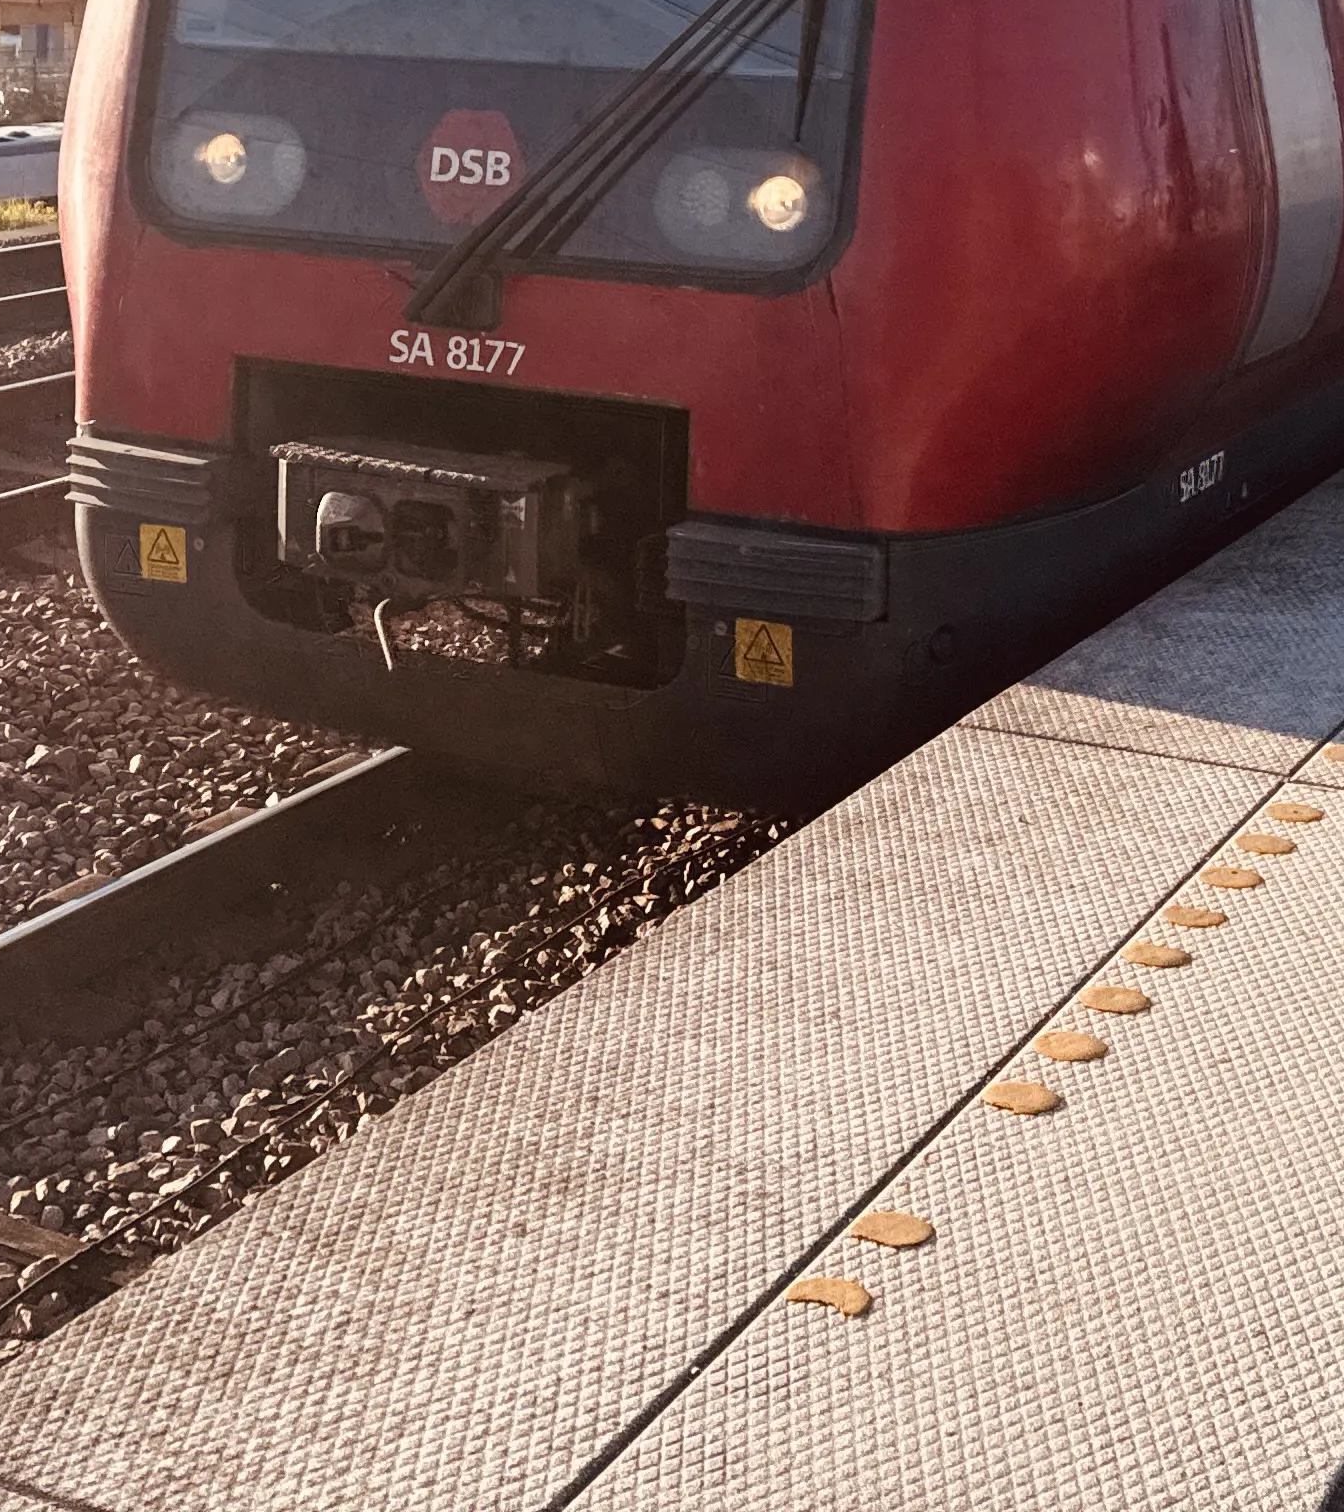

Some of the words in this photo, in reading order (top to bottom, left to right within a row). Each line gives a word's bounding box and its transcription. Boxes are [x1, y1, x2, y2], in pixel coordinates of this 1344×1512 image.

[430, 146, 511, 186] DSB
[389, 329, 435, 367] SA
[446, 335, 526, 376] 8177
